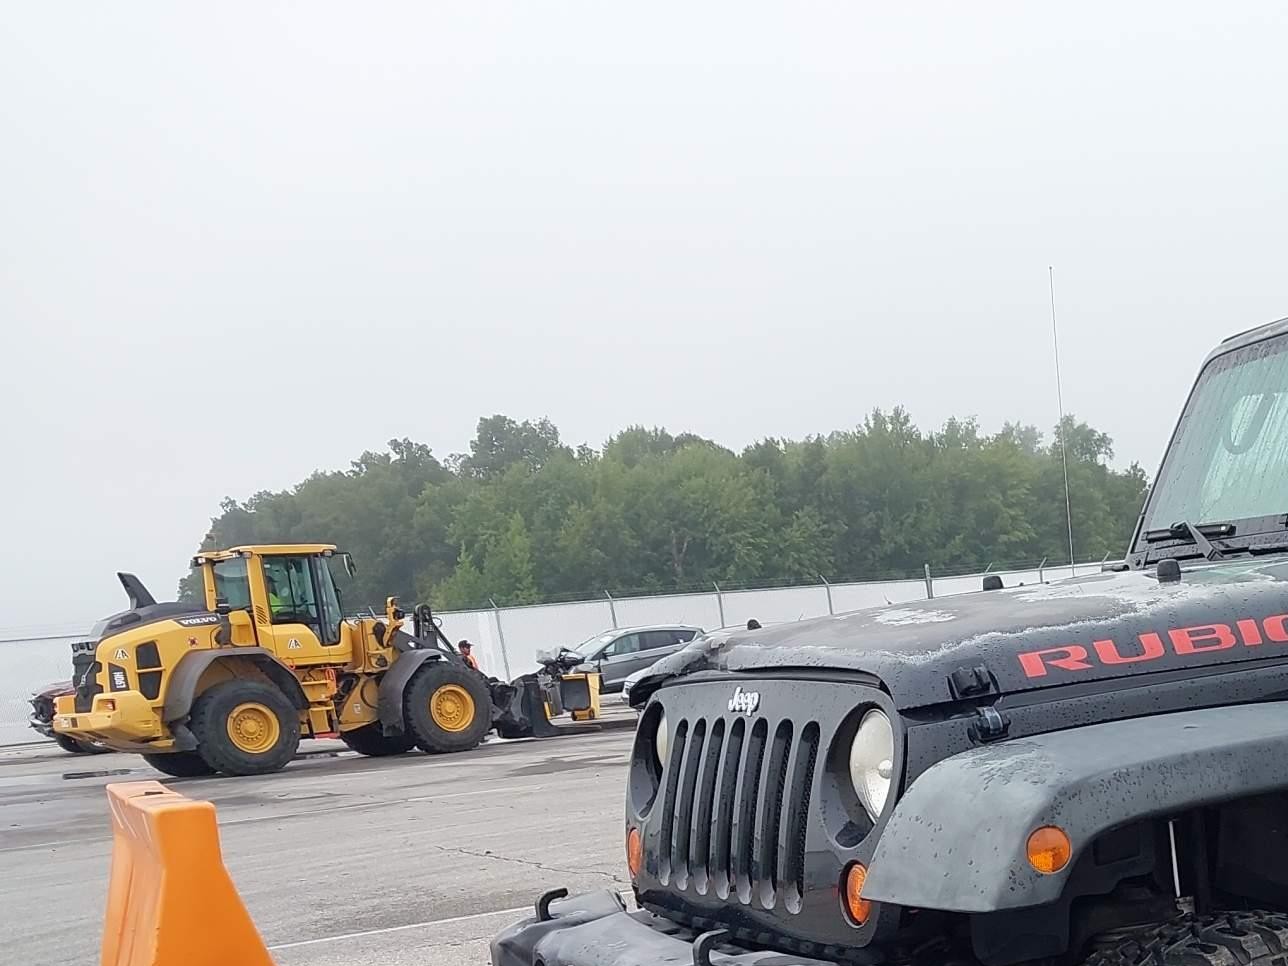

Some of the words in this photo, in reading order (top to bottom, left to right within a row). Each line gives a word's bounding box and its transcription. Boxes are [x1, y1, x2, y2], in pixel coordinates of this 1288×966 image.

[179, 616, 218, 625] VOLVO
[112, 671, 127, 689] L90H
[727, 686, 761, 717] Jeep
